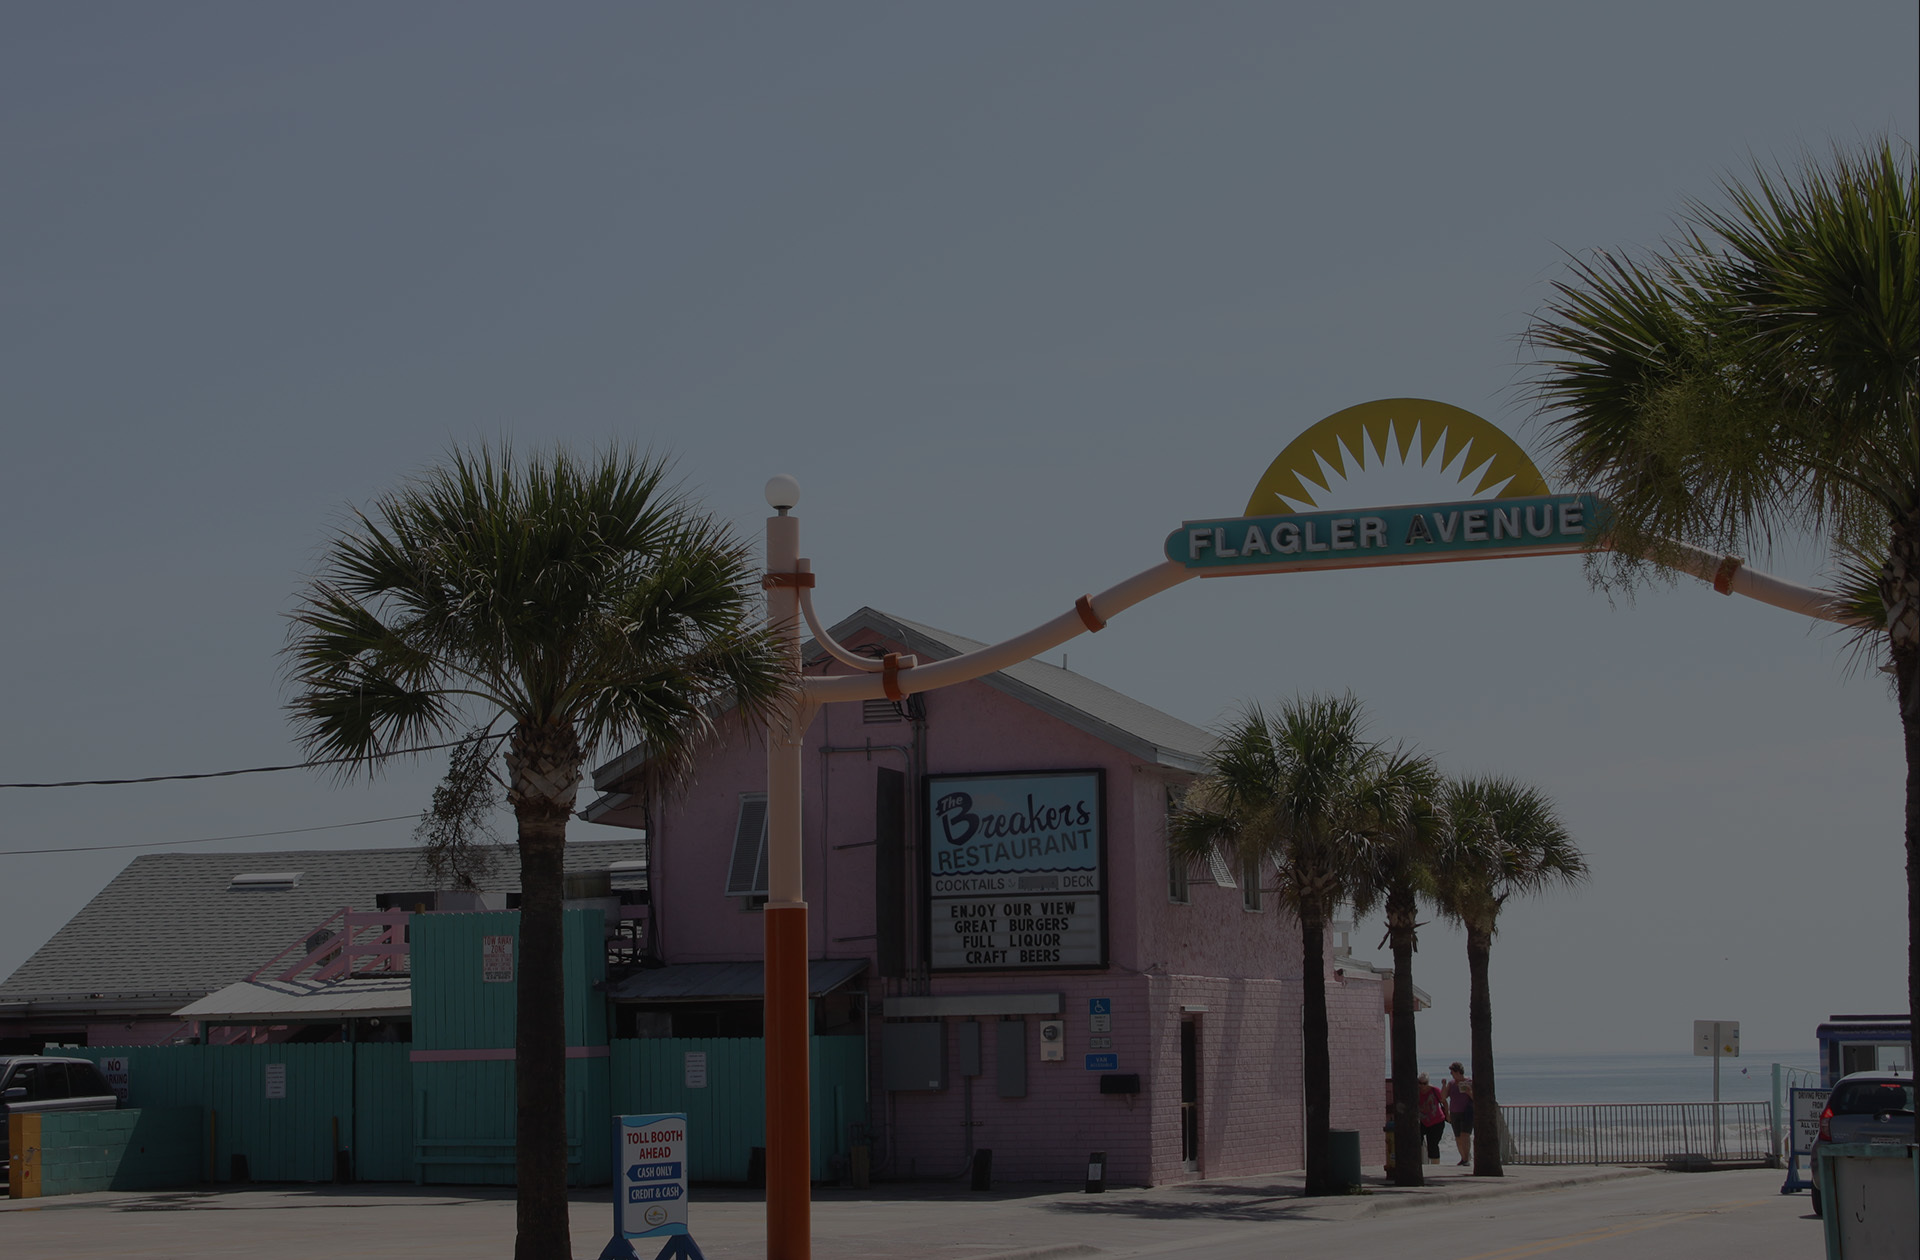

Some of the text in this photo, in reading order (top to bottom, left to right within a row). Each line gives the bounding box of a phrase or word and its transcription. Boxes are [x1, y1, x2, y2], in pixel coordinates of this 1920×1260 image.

[1189, 502, 1585, 560] FLAGLER AVENUE
[936, 792, 1091, 846] The Breakers
[938, 829, 1091, 870] RESTAURANT
[935, 875, 1093, 891] COCKTAILS DECK
[951, 901, 1076, 918] ENJOY OUR VIEW
[954, 917, 1069, 933] GREAT BURGERS
[484, 936, 512, 945] TOW AWAY
[963, 933, 1061, 949] FULL LIQUOR
[491, 944, 505, 954] ZONE
[966, 949, 1060, 964] CRAFT BEERS
[108, 1060, 121, 1071] NO
[627, 1130, 683, 1144] TOLL BOOTH
[639, 1146, 671, 1160] AHEAD
[637, 1165, 673, 1178] CASH ONLY
[631, 1186, 680, 1200] CREDIT & CASH
